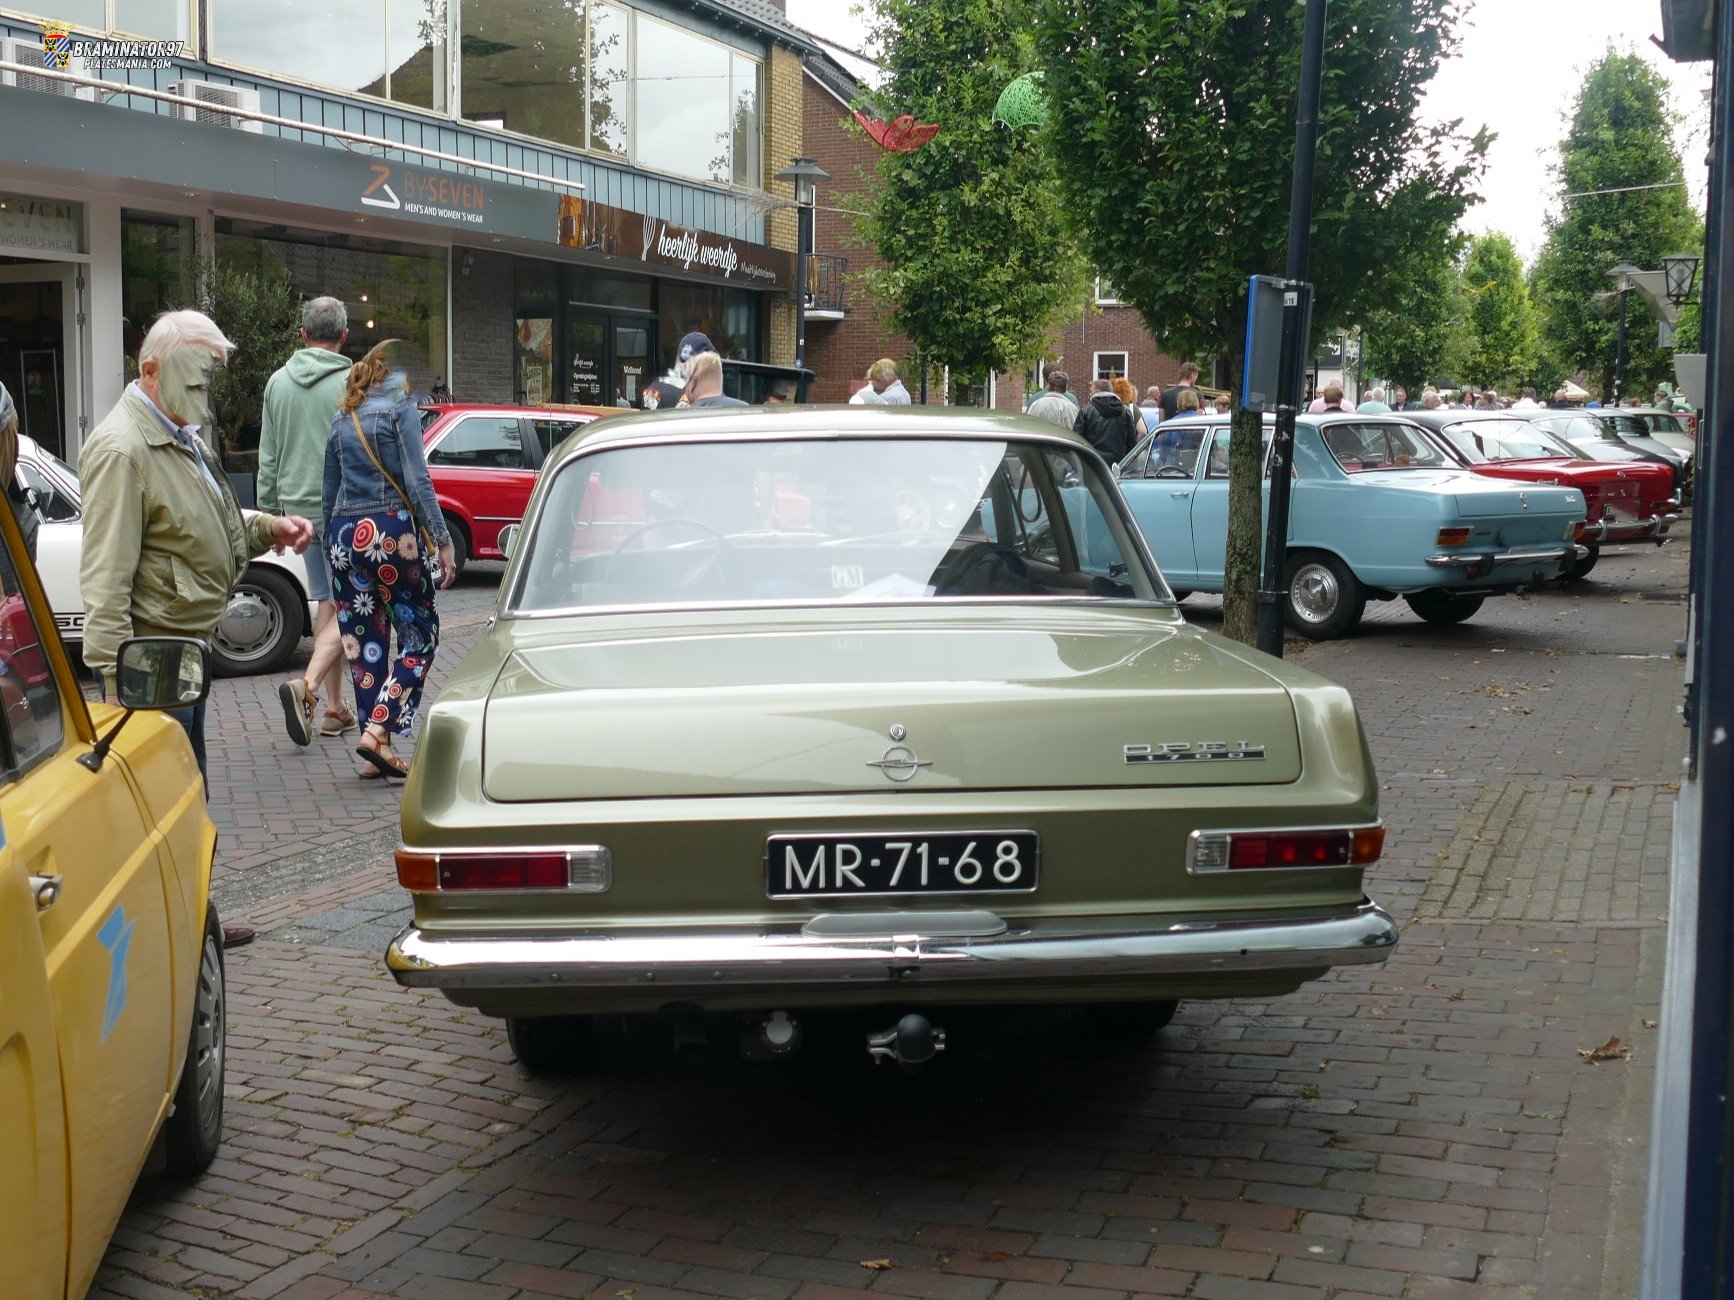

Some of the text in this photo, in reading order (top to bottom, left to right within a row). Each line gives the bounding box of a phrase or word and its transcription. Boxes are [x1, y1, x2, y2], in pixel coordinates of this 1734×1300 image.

[404, 202, 424, 214] MEN'S
[423, 206, 438, 216] AND
[467, 213, 484, 224] WEAR
[47, 239, 73, 251] WEAR
[657, 223, 738, 279] heerlijk weerdje
[833, 567, 861, 586] GM
[1123, 740, 1265, 755] OPEL
[1146, 752, 1245, 761] 1700
[785, 840, 1022, 890] MR-71-68
